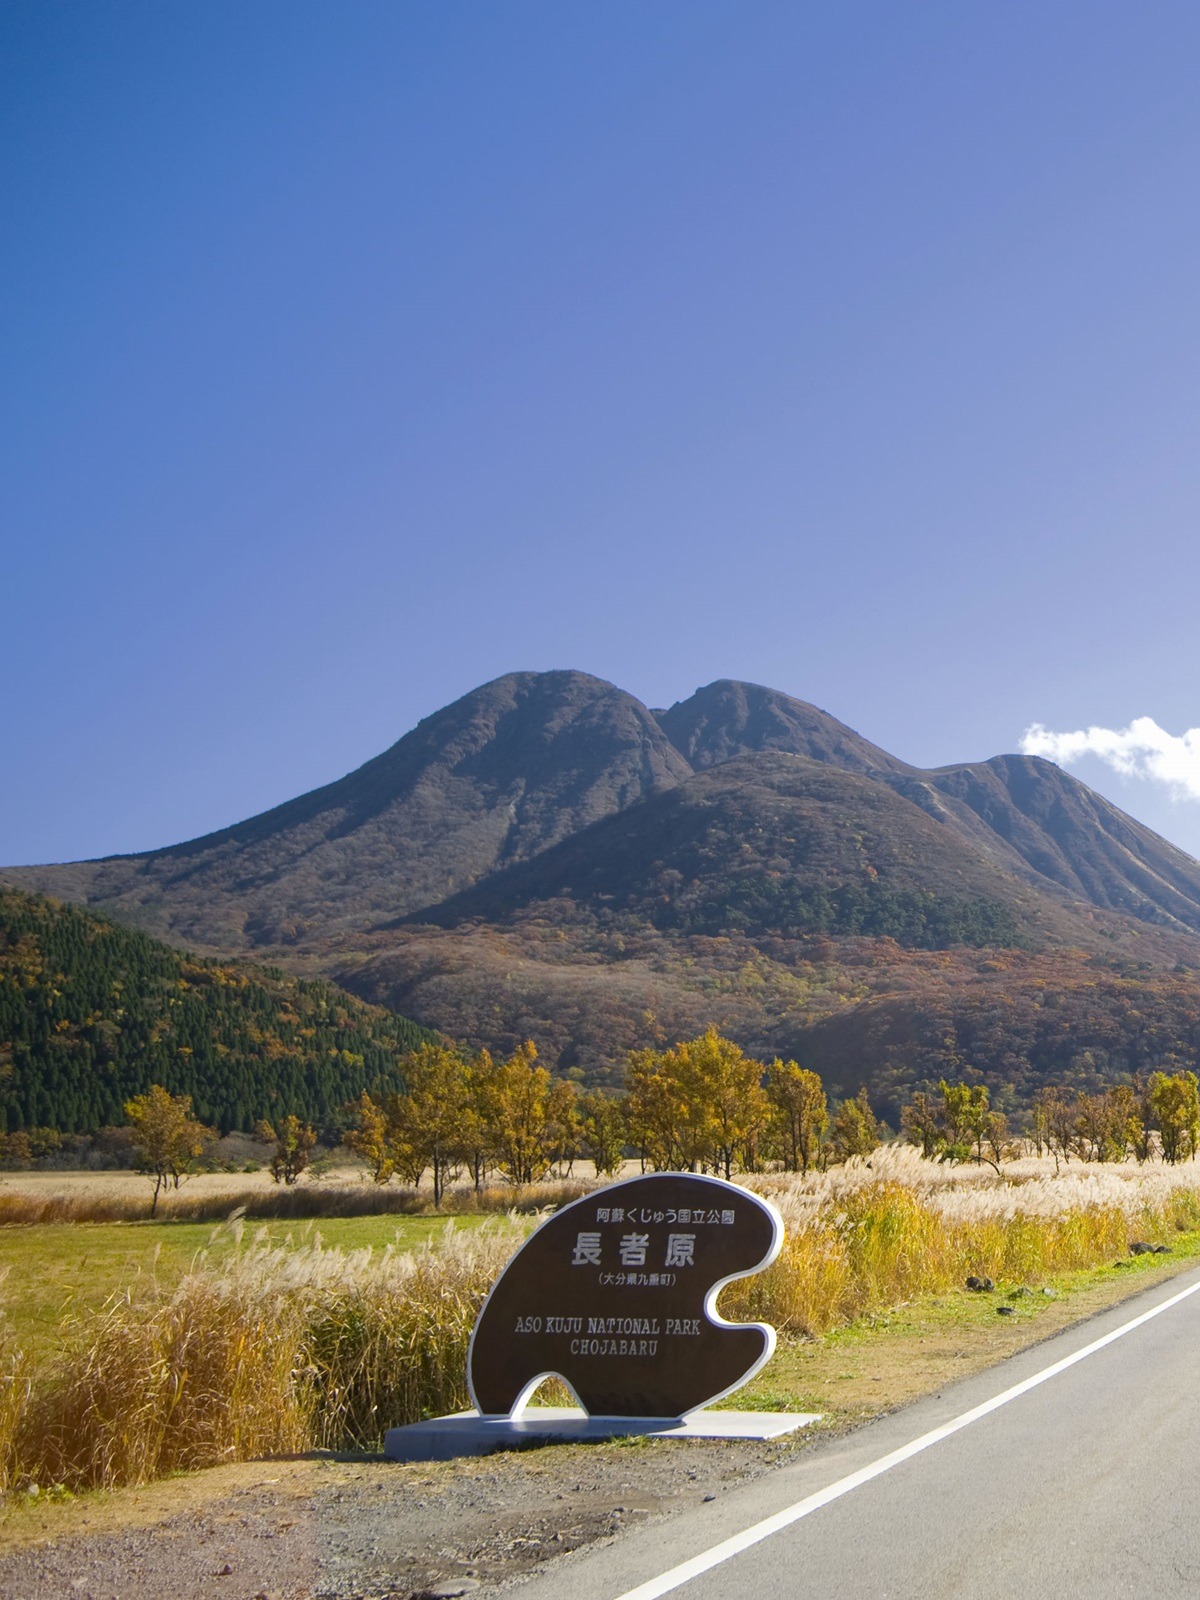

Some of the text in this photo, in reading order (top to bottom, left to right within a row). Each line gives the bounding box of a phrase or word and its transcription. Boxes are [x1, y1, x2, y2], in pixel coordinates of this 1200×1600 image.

[571, 1231, 697, 1267] 長者原
[514, 1316, 701, 1336] ASO KUJU NATIONAL PARK
[570, 1339, 658, 1356] CHOJABARU
